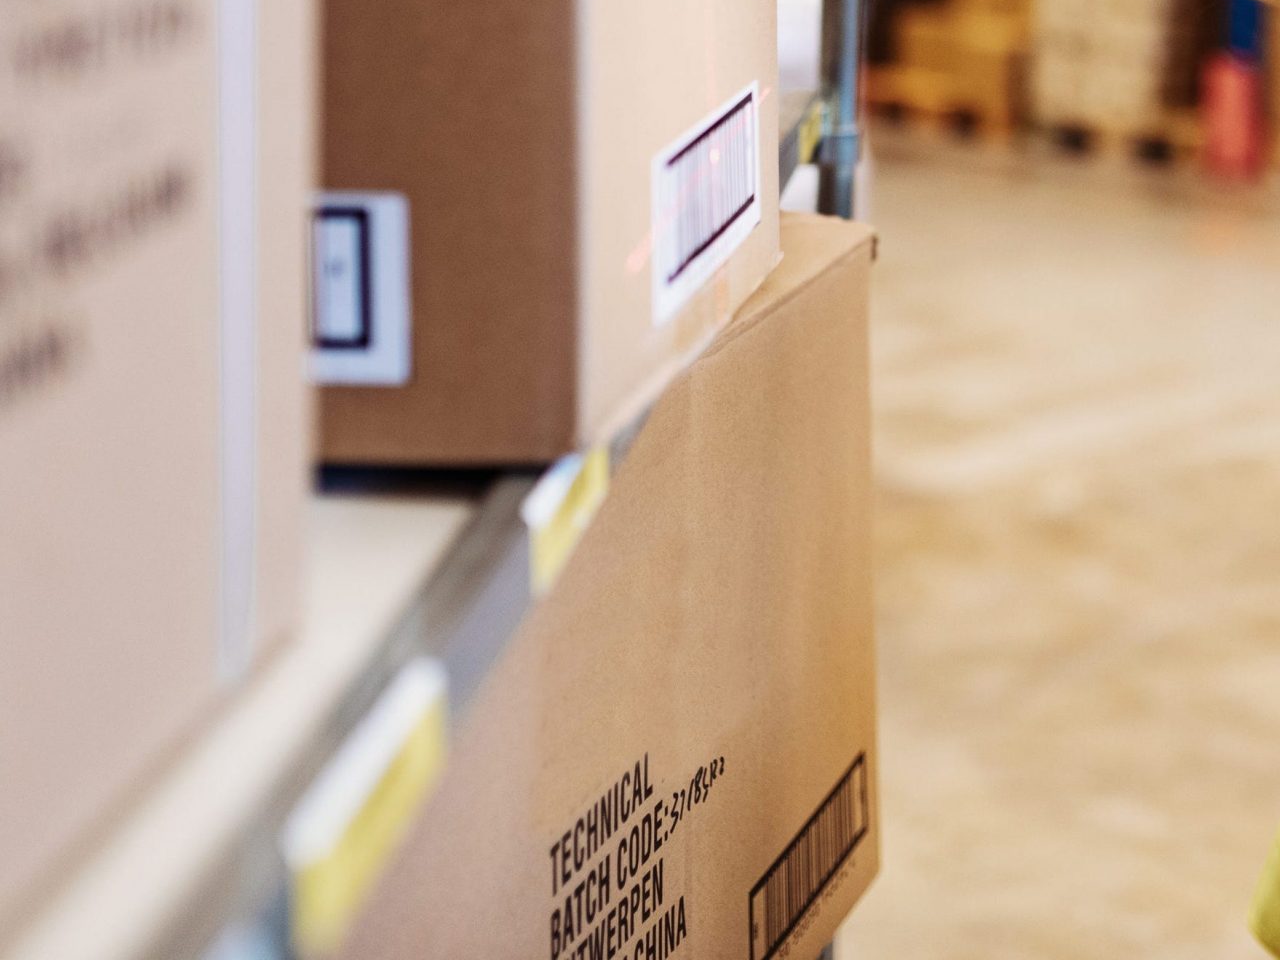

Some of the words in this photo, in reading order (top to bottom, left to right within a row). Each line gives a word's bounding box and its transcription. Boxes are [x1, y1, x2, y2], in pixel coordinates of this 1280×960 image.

[550, 752, 653, 897] TECHNICAL
[550, 853, 610, 960] BATCH
[617, 800, 668, 890] CODE:
